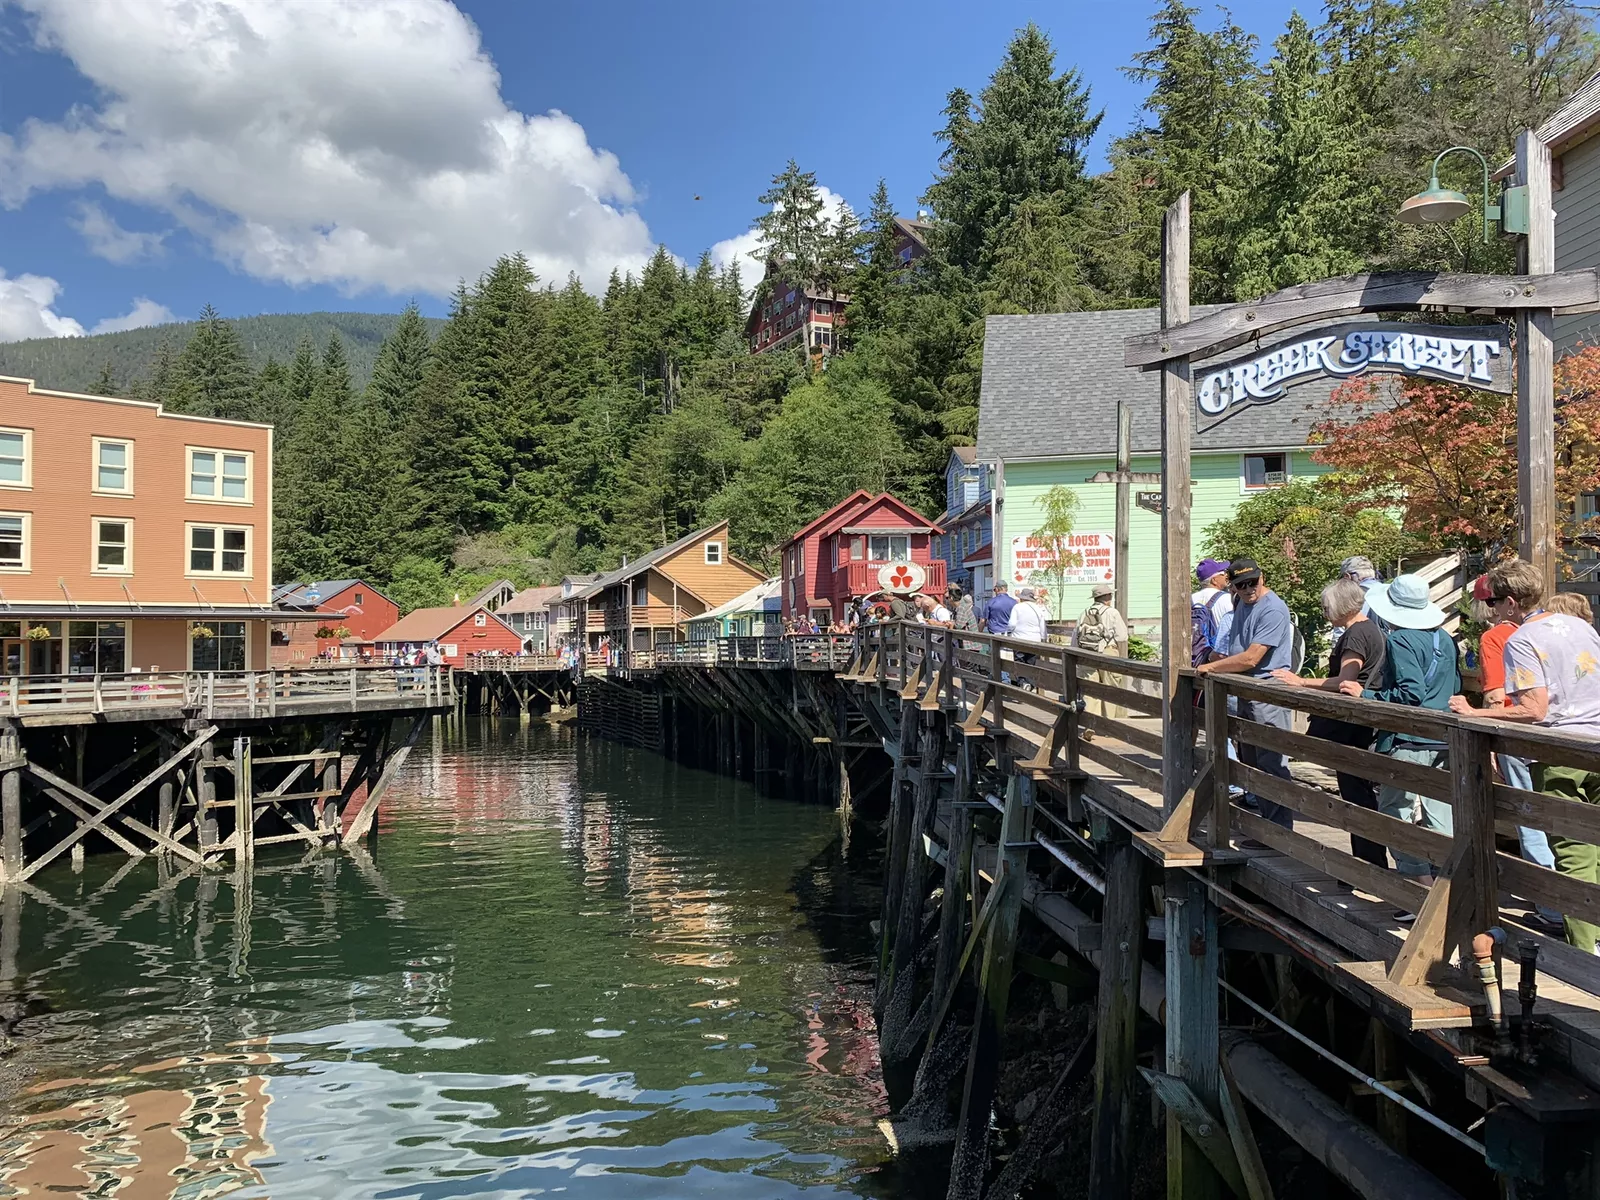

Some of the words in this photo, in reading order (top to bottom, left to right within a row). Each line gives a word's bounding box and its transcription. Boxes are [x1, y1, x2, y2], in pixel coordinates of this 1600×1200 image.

[1199, 335, 1368, 414] CREEK
[1341, 330, 1500, 382] STREET
[1068, 535, 1100, 547] HOUSE
[1016, 551, 1037, 559] WHERE
[1085, 549, 1110, 557] SALMON
[1017, 560, 1034, 569] CAME
[1086, 558, 1110, 567] SPAWN
